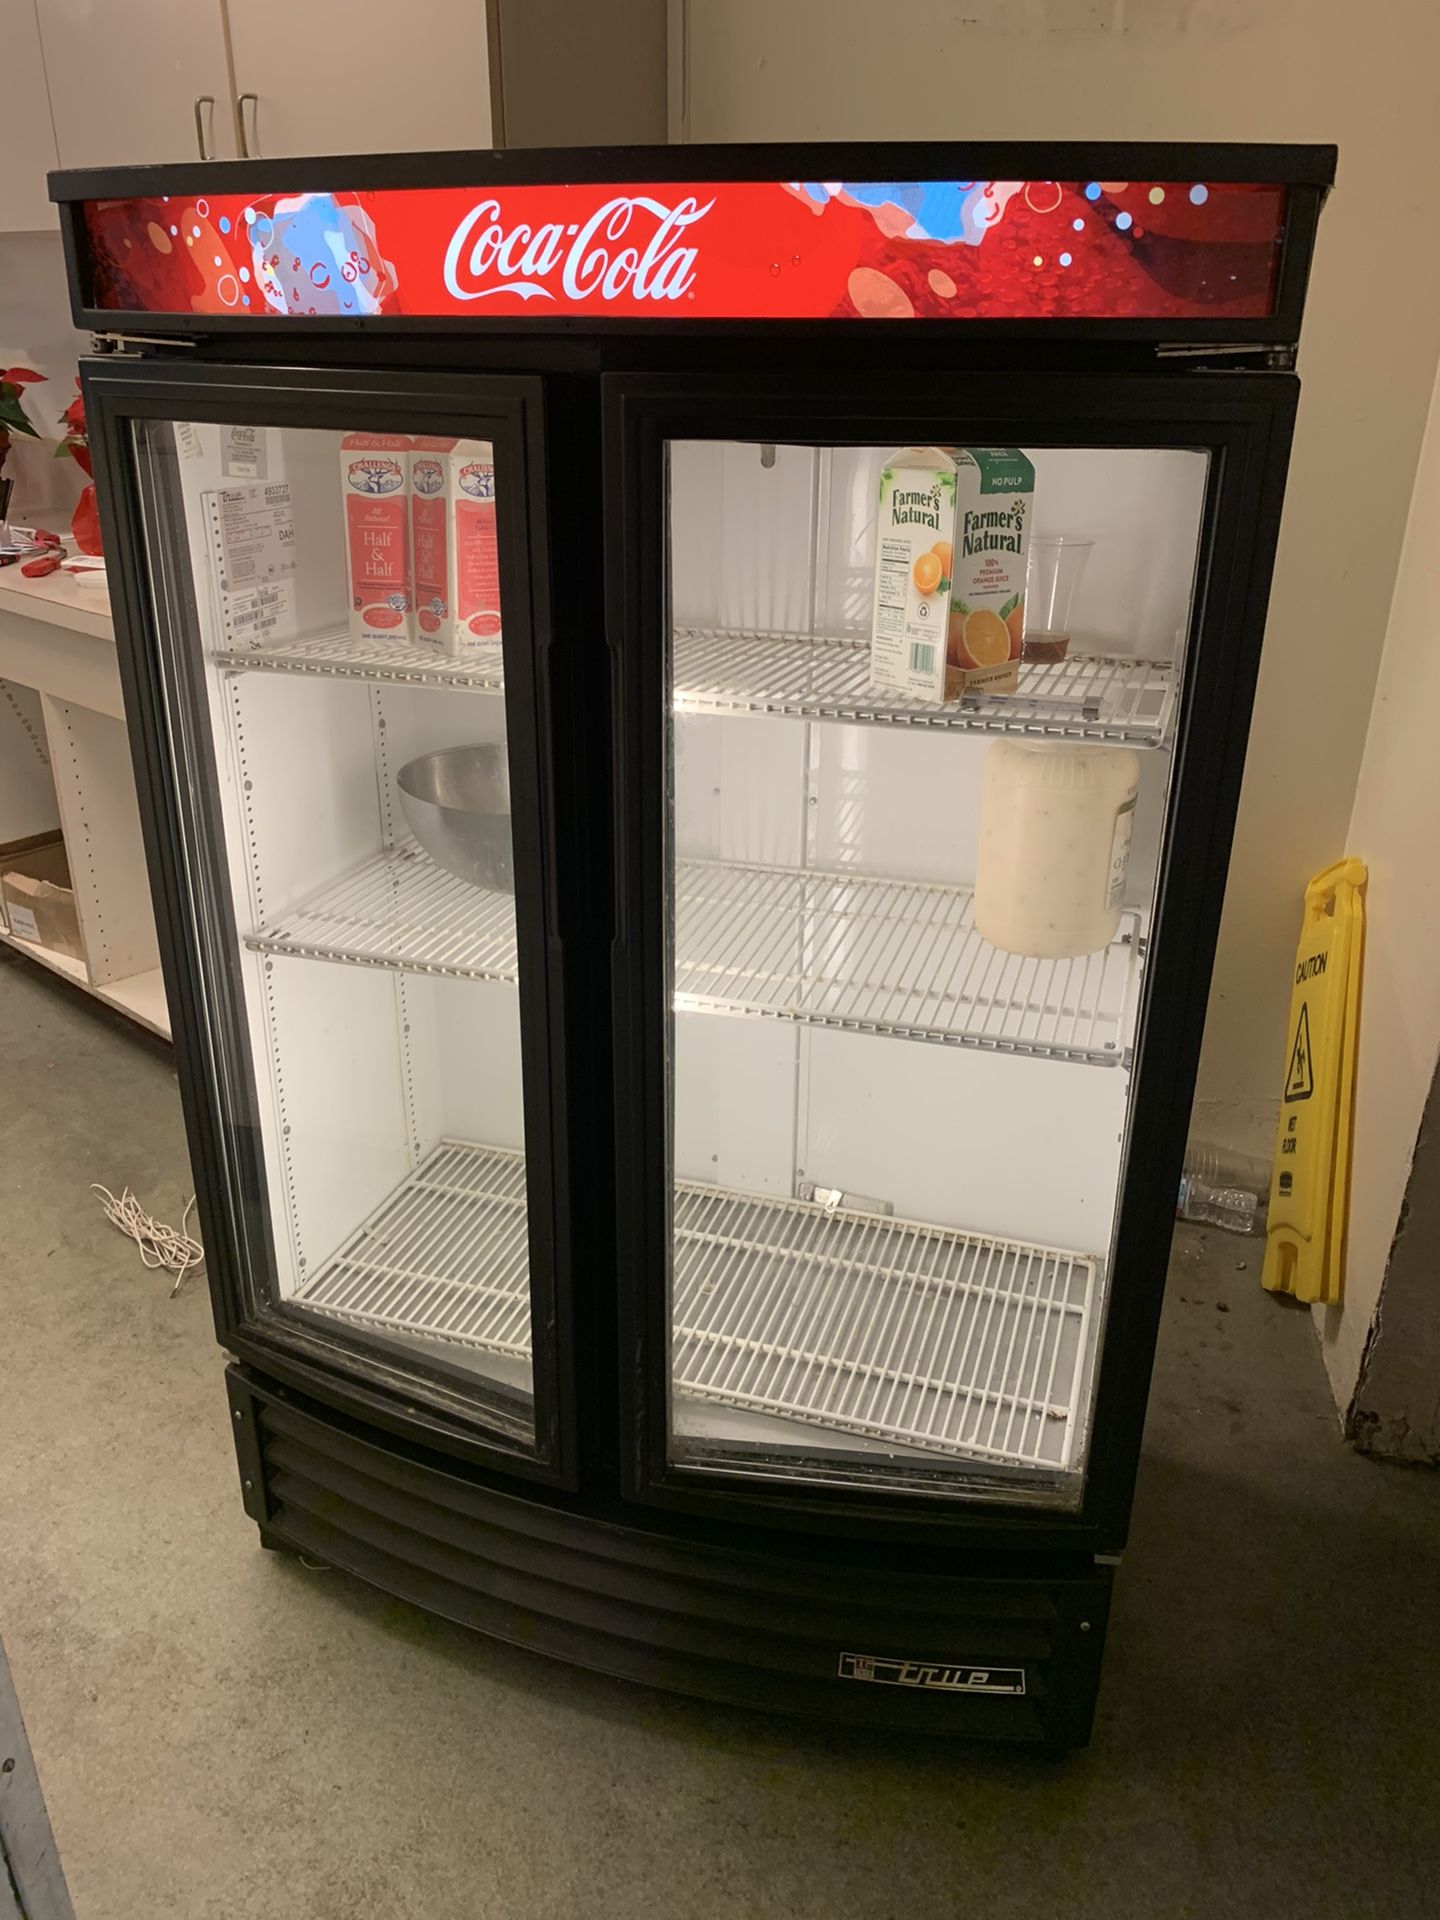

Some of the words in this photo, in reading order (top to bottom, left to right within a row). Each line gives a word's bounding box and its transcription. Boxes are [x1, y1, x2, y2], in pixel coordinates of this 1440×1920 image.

[443, 196, 717, 302] Coca-Cola
[991, 477, 1003, 486] NO
[1003, 476, 1023, 486] PULP
[892, 488, 940, 511] Farmer's
[891, 506, 940, 531] Natural
[963, 510, 1023, 534] Farmer's
[363, 532, 393, 547] Half
[962, 530, 1022, 559] Natural
[371, 548, 384, 561] &
[365, 561, 394, 577] Half
[972, 576, 994, 584] ORANGE
[1296, 951, 1328, 985] CAUTION
